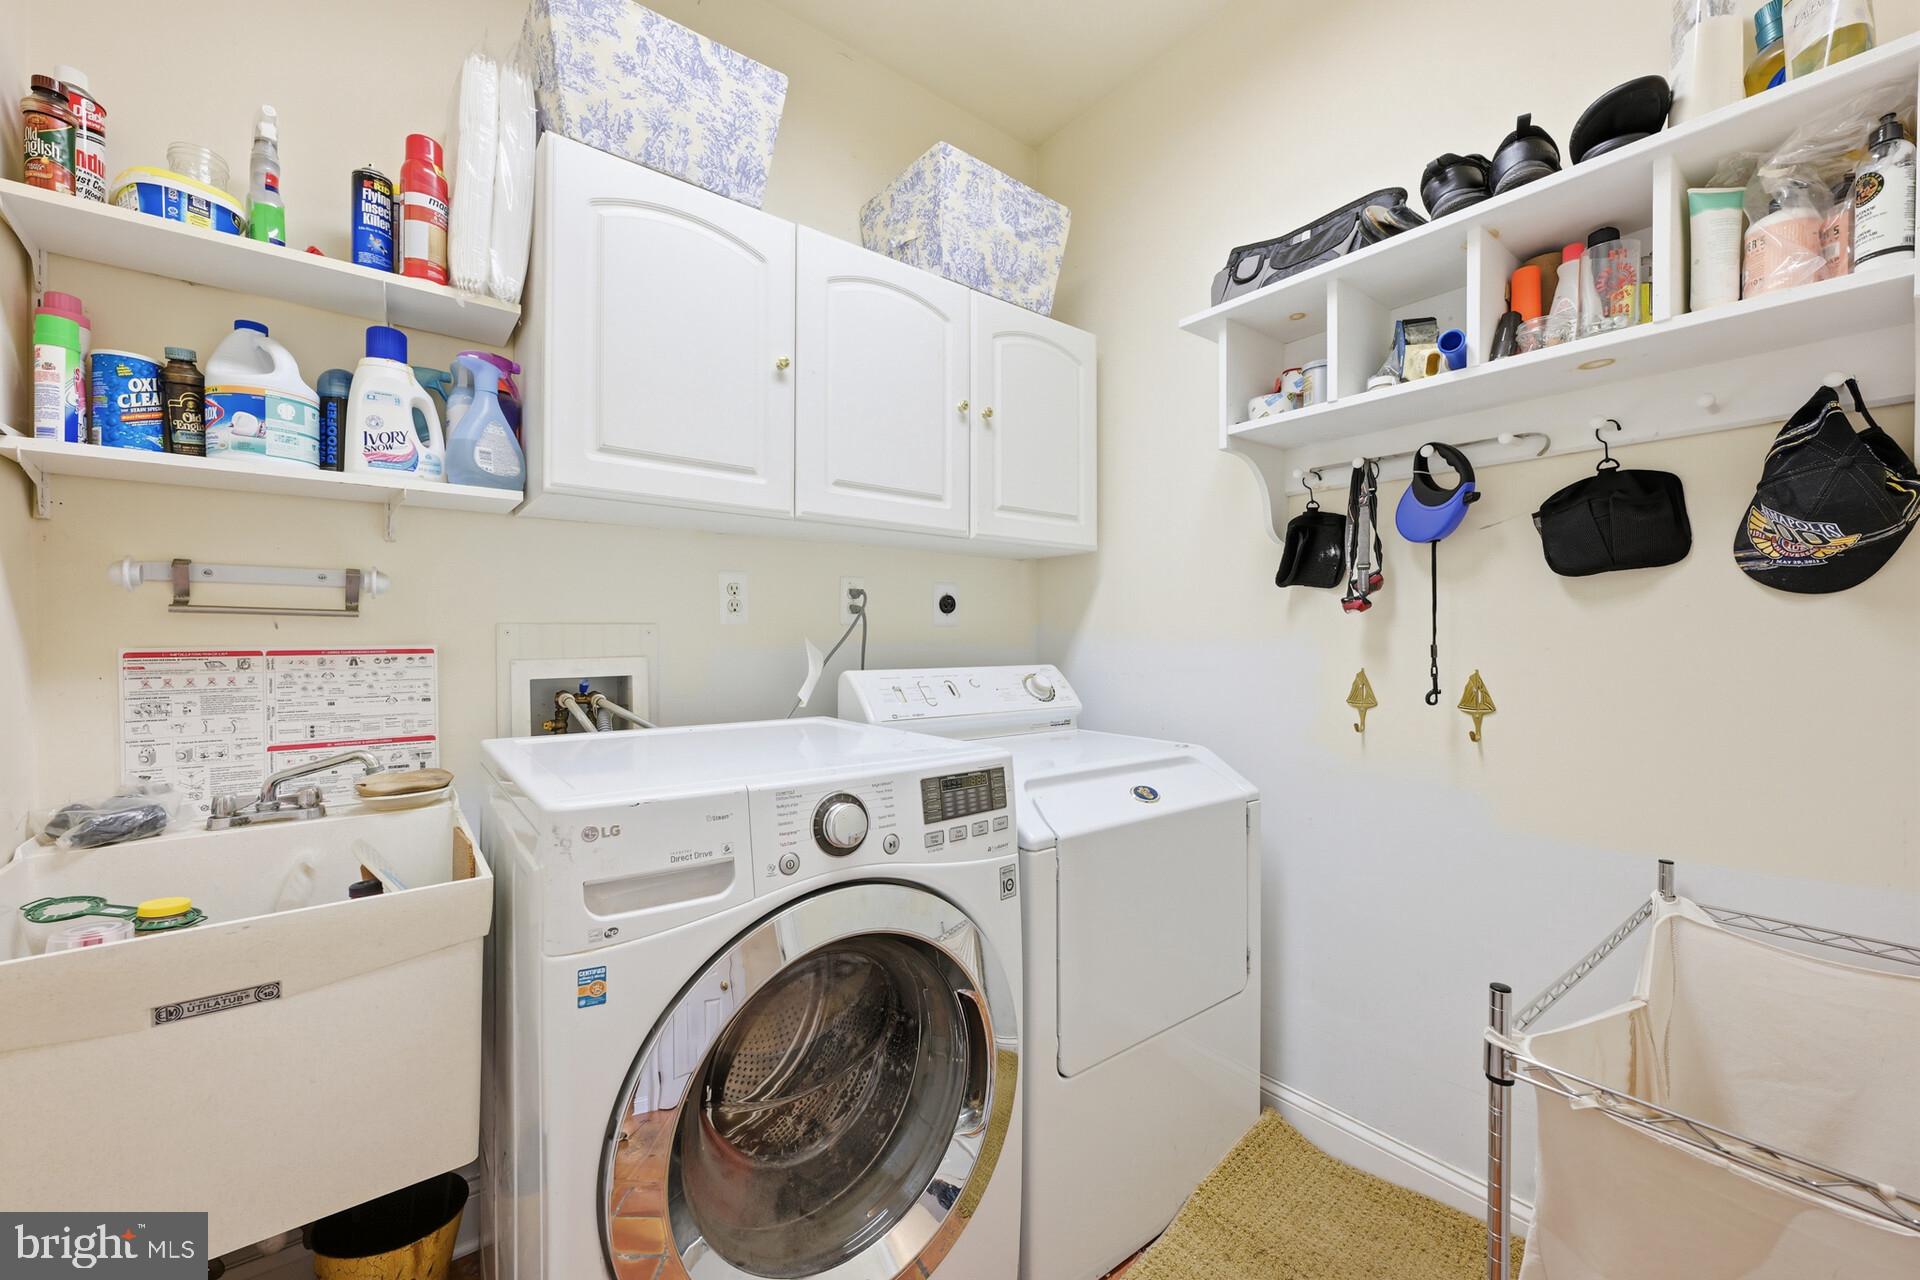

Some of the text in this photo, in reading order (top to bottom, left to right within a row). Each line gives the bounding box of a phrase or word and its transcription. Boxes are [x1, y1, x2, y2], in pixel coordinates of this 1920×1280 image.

[362, 187, 391, 210] Flying
[361, 199, 392, 221] Insect
[363, 212, 391, 231] Killer
[127, 377, 158, 393] OXI
[117, 391, 162, 408] CLEA
[327, 401, 337, 465] PROOFER
[363, 430, 409, 446] IVORY
[363, 443, 394, 453] SNOW
[601, 824, 621, 838] LG
[670, 850, 713, 864] Direct Drive
